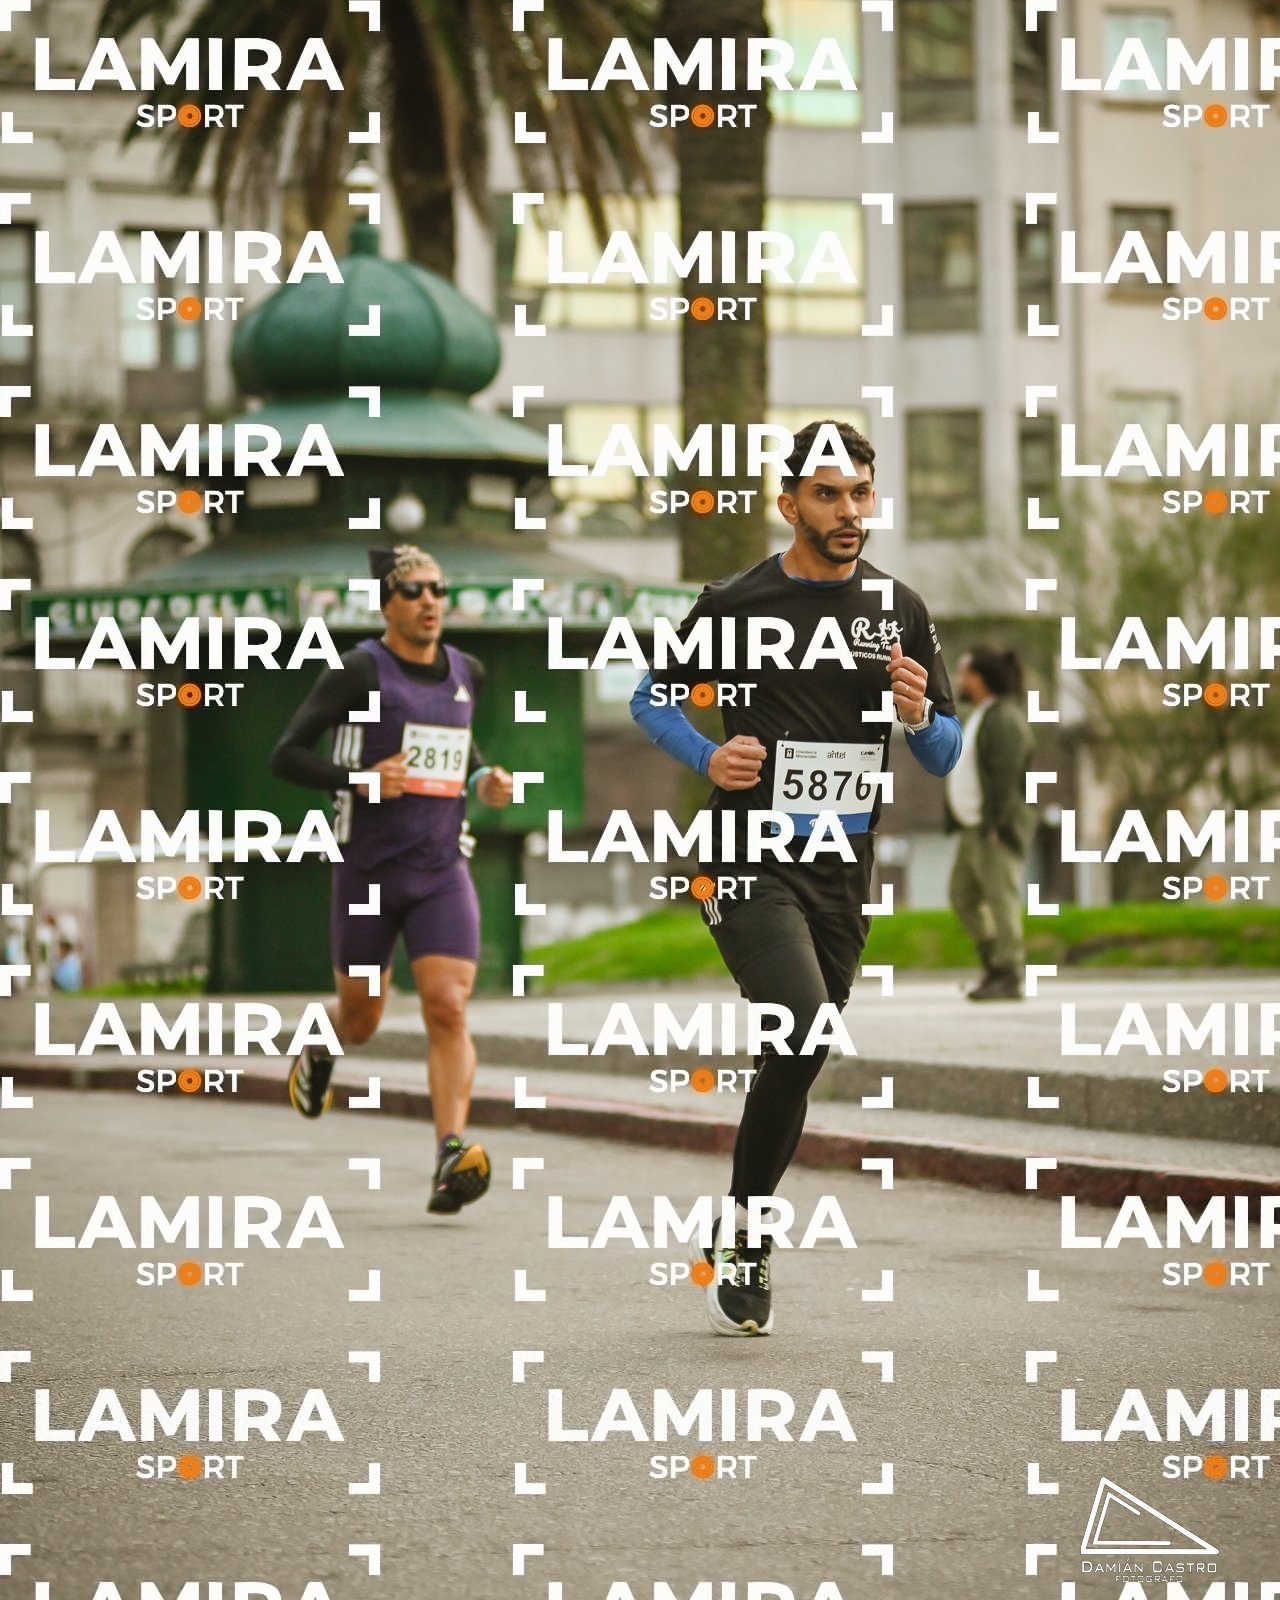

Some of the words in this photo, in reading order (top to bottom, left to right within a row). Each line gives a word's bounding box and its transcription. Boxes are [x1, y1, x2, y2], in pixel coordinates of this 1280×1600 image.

[851, 651, 876, 660] USTICOS
[881, 641, 892, 651] Tea
[406, 744, 463, 772] 2819
[782, 768, 872, 802] 5876
